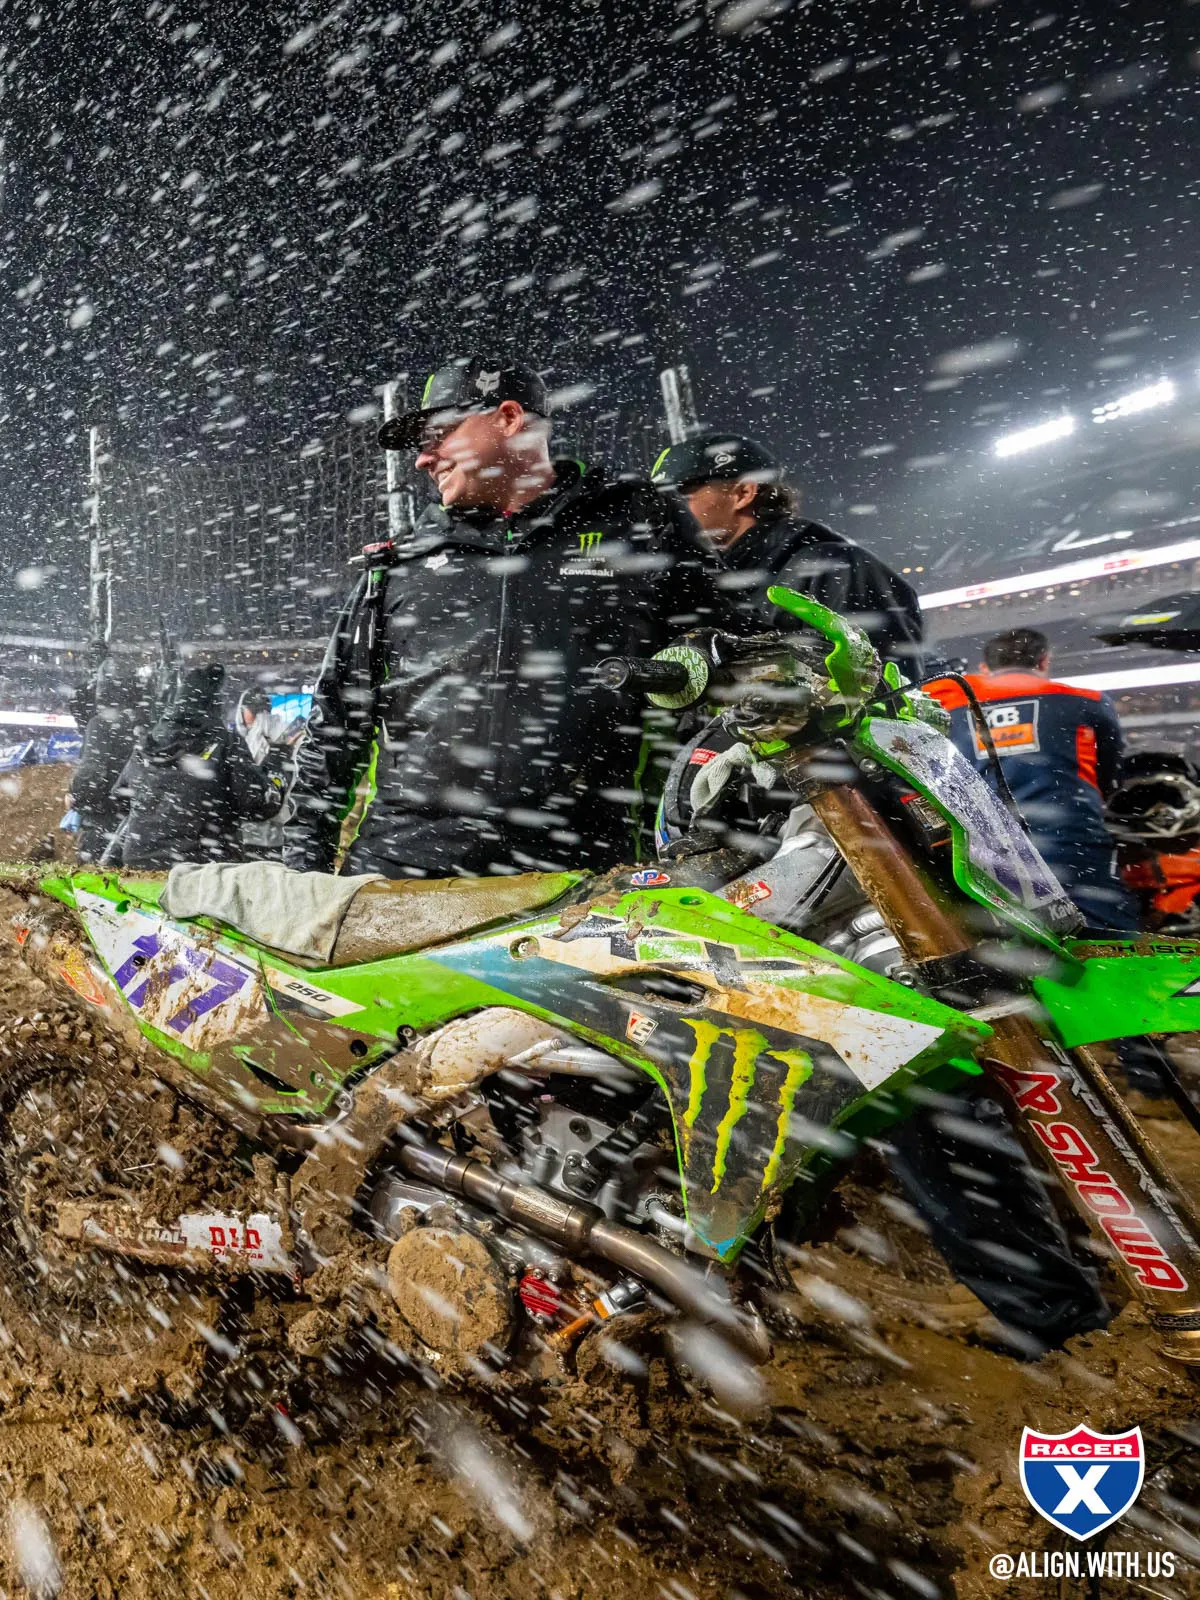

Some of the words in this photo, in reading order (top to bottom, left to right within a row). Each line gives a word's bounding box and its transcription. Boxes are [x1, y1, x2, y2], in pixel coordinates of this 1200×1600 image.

[559, 567, 614, 577] Kawasaki
[284, 982, 333, 1002] 250
[1028, 1119, 1188, 1292] SHOWA
